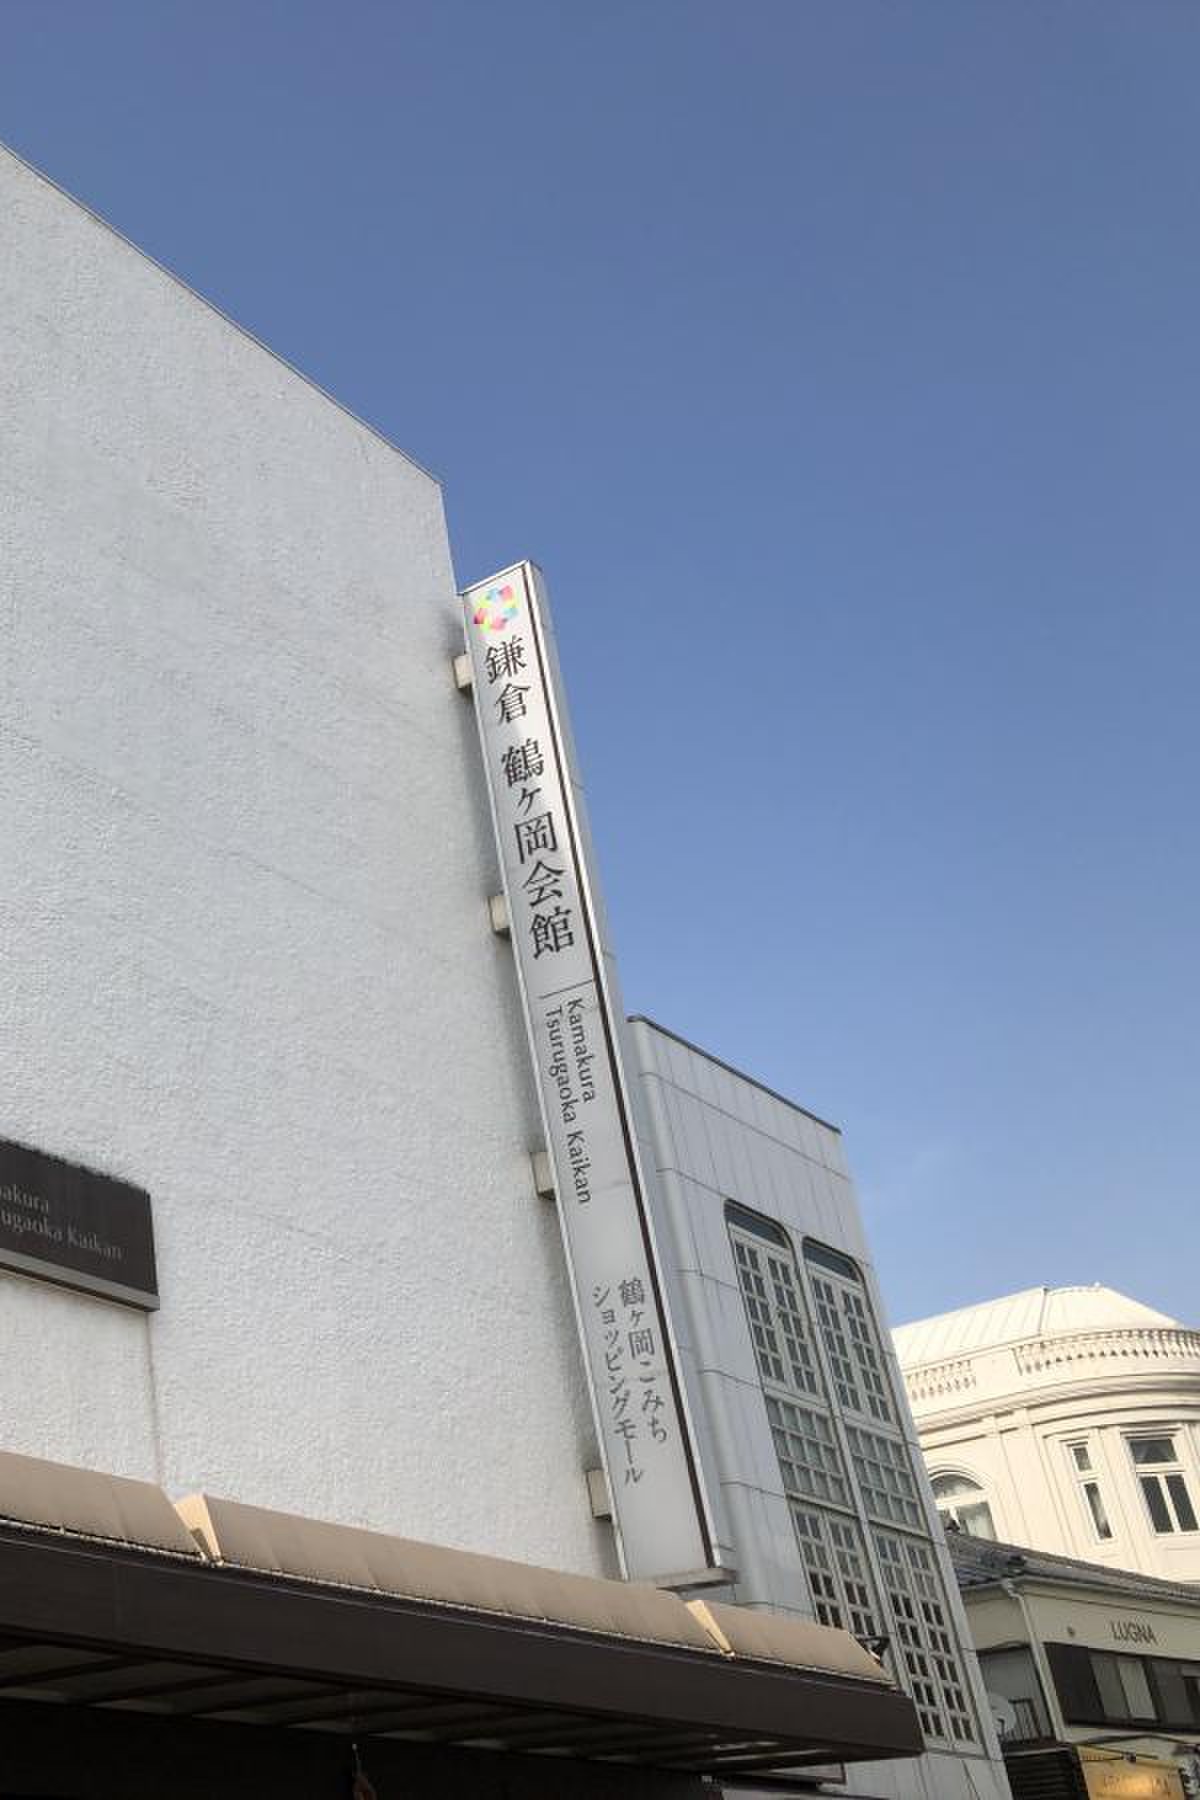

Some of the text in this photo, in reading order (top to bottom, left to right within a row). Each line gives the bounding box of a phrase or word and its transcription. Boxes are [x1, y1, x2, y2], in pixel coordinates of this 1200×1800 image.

[484, 633, 575, 960] 鎌倉 鶴ヶ岡会館
[545, 1006, 592, 1204] Tsurugaoka Kaikan
[567, 998, 597, 1103] Kamakura
[66, 1223, 124, 1261] Kaikan
[592, 1285, 644, 1485] ショッピングモール
